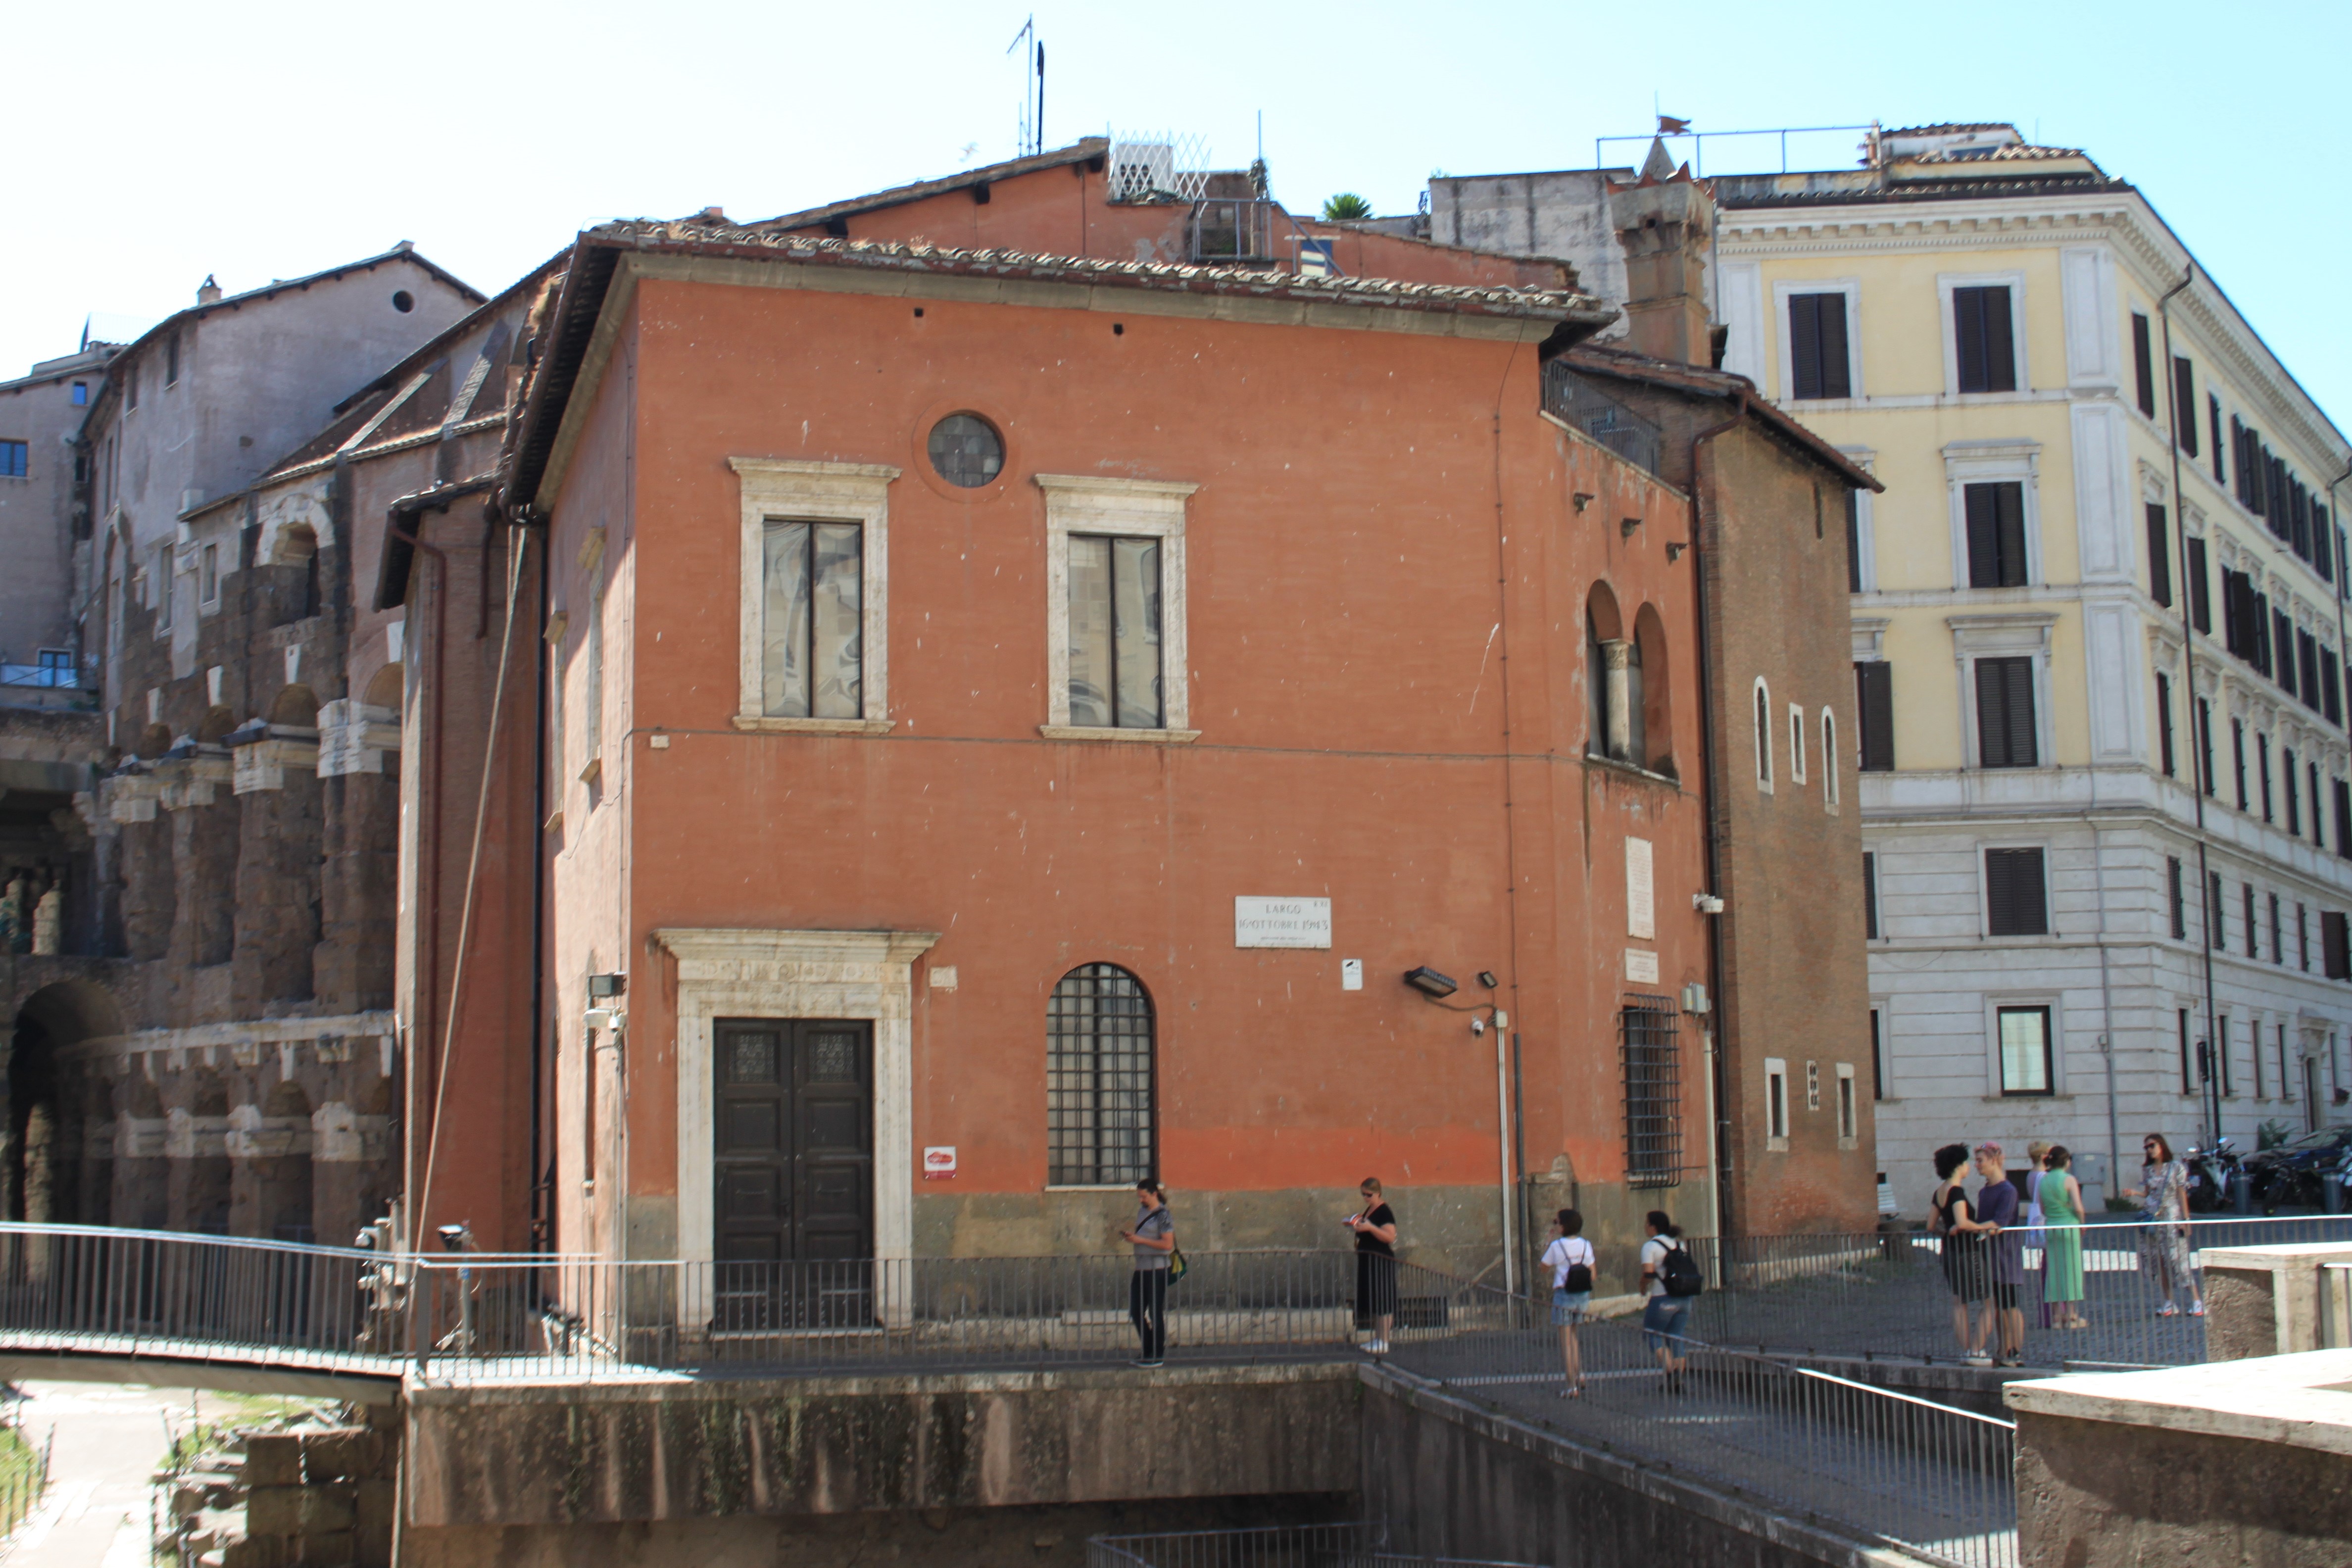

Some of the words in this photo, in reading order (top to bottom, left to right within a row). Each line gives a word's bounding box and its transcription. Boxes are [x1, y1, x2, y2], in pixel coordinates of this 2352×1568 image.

[1266, 904, 1302, 914] LARGO
[1251, 920, 1300, 930] OTTOBRE
[1302, 920, 1328, 931] 1943
